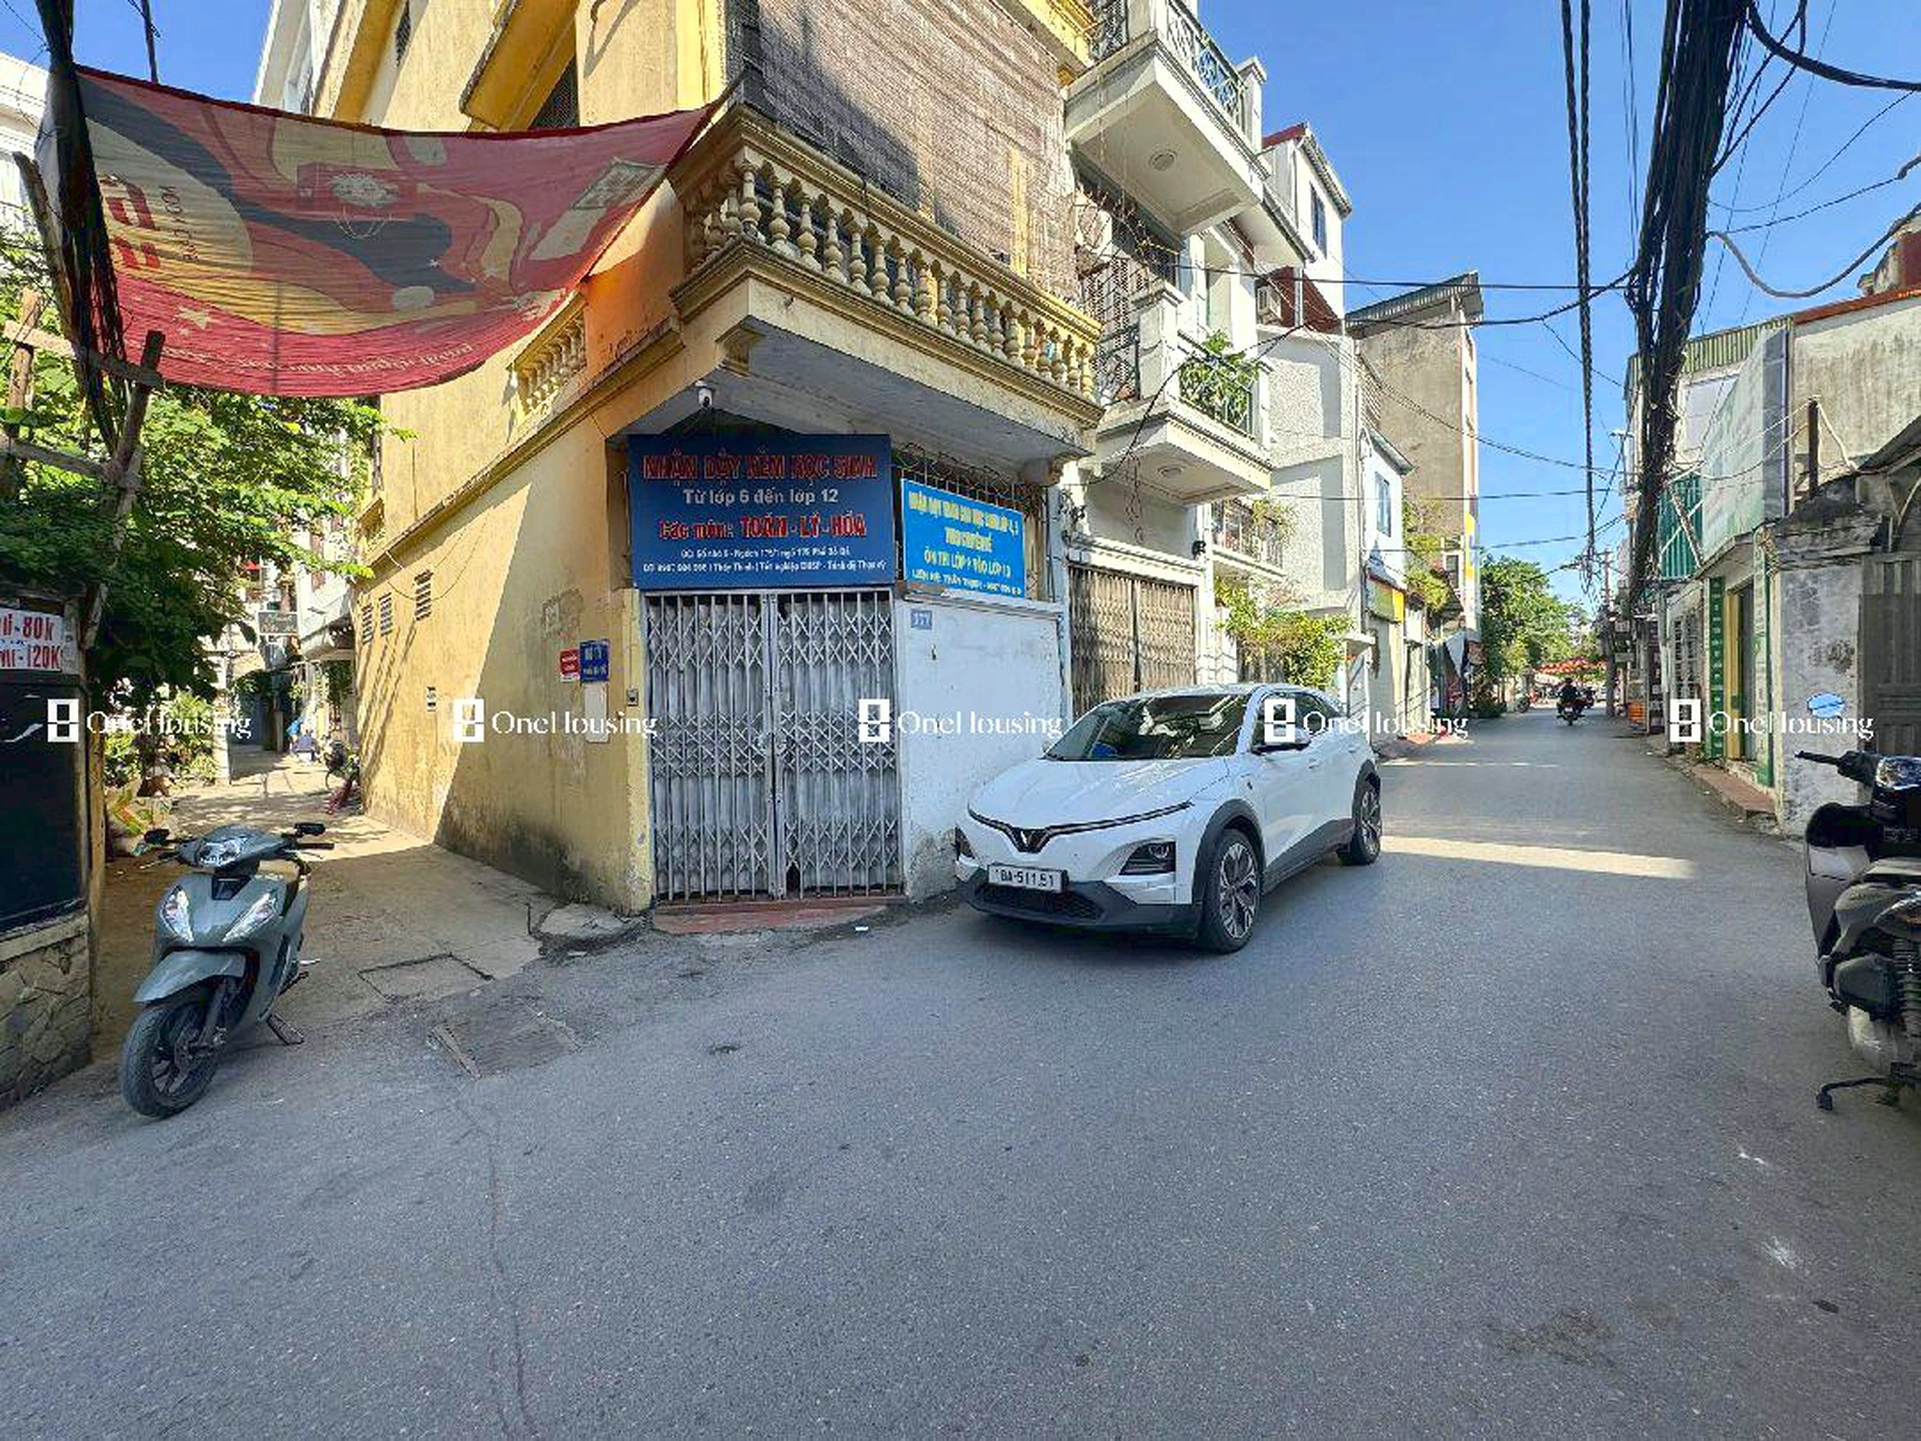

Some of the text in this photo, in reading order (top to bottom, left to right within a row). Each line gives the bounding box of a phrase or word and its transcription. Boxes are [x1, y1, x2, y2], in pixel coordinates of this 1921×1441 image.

[791, 455, 830, 486] HỌC
[834, 455, 877, 479] SINH
[683, 486, 839, 507] Từ lớp 6 đến lớp 12
[740, 512, 787, 539] TOÁN
[800, 511, 820, 539] LÝ
[27, 644, 61, 669] 120K
